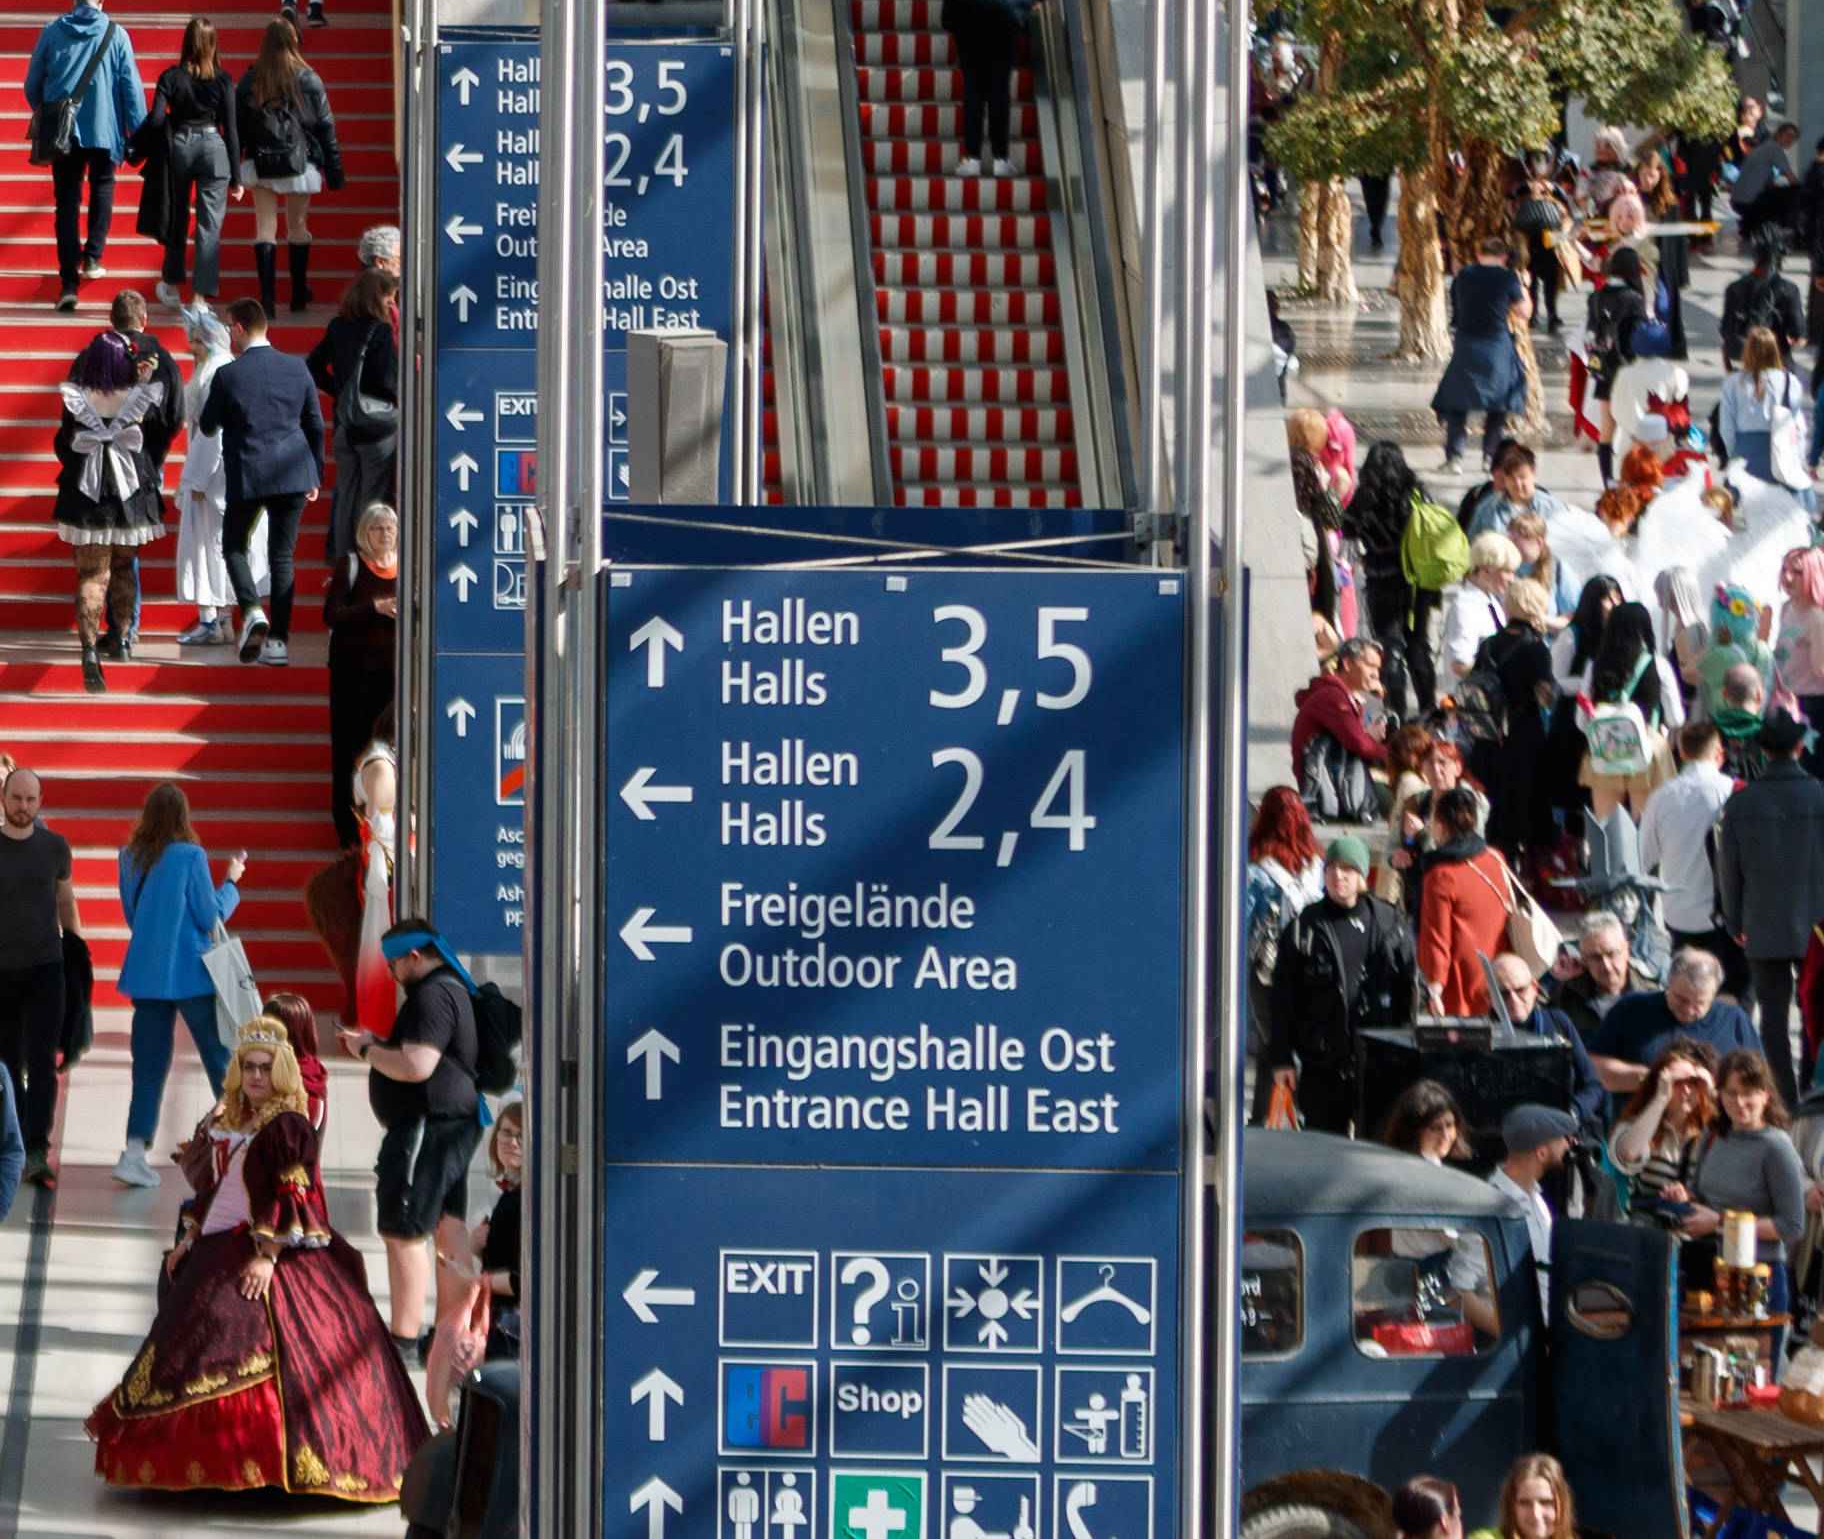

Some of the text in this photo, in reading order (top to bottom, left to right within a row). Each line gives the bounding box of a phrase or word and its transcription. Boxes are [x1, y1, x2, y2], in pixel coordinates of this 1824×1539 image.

[497, 58, 687, 123] Hall 3,5
[497, 90, 541, 113] Hall
[497, 131, 688, 195] Hall 2,4
[497, 162, 541, 185] Hall
[660, 277, 699, 300] Ost
[603, 308, 645, 330] Hall
[652, 308, 701, 330] East
[721, 599, 1093, 725] Hallen 3,5
[721, 660, 827, 706] Halls
[721, 739, 1096, 867] Hallen 2,4
[721, 800, 827, 846] Halls
[720, 882, 975, 938] Freigelände
[719, 944, 1017, 990] Outdoor Area
[720, 1024, 1116, 1079] Eingangshalle Ost
[719, 1084, 1119, 1134] Entrance Hall East
[727, 1262, 812, 1295] EXIT
[837, 1382, 923, 1419] Shop
